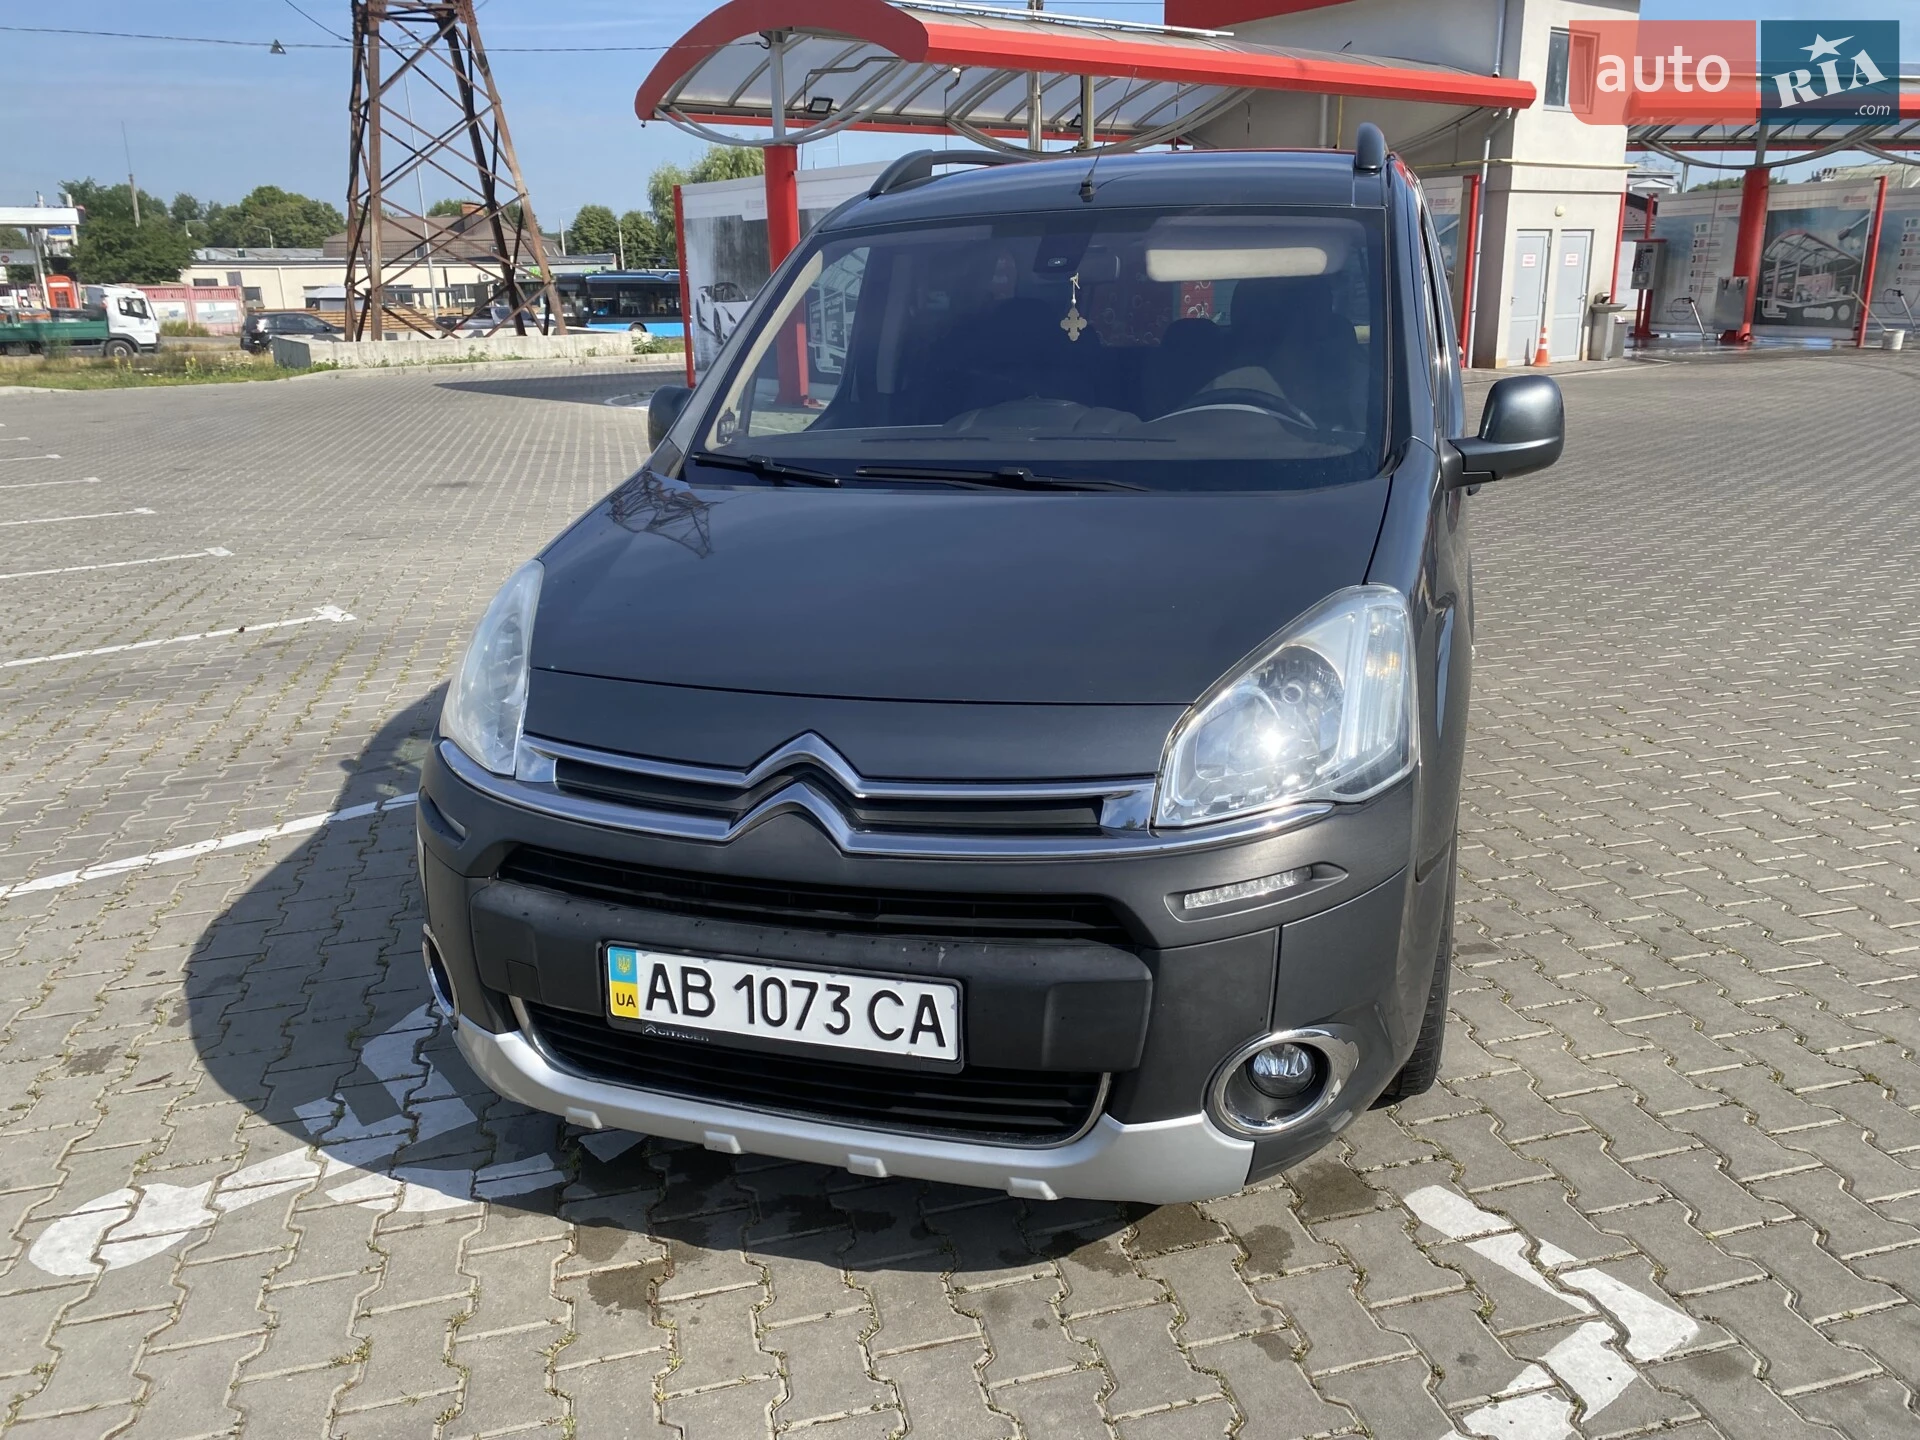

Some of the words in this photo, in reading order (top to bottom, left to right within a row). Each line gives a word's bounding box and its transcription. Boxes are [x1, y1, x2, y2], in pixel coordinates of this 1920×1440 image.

[615, 991, 637, 1009] UA
[645, 963, 716, 1019] AB
[734, 973, 852, 1036] 1073
[867, 989, 947, 1048] CA
